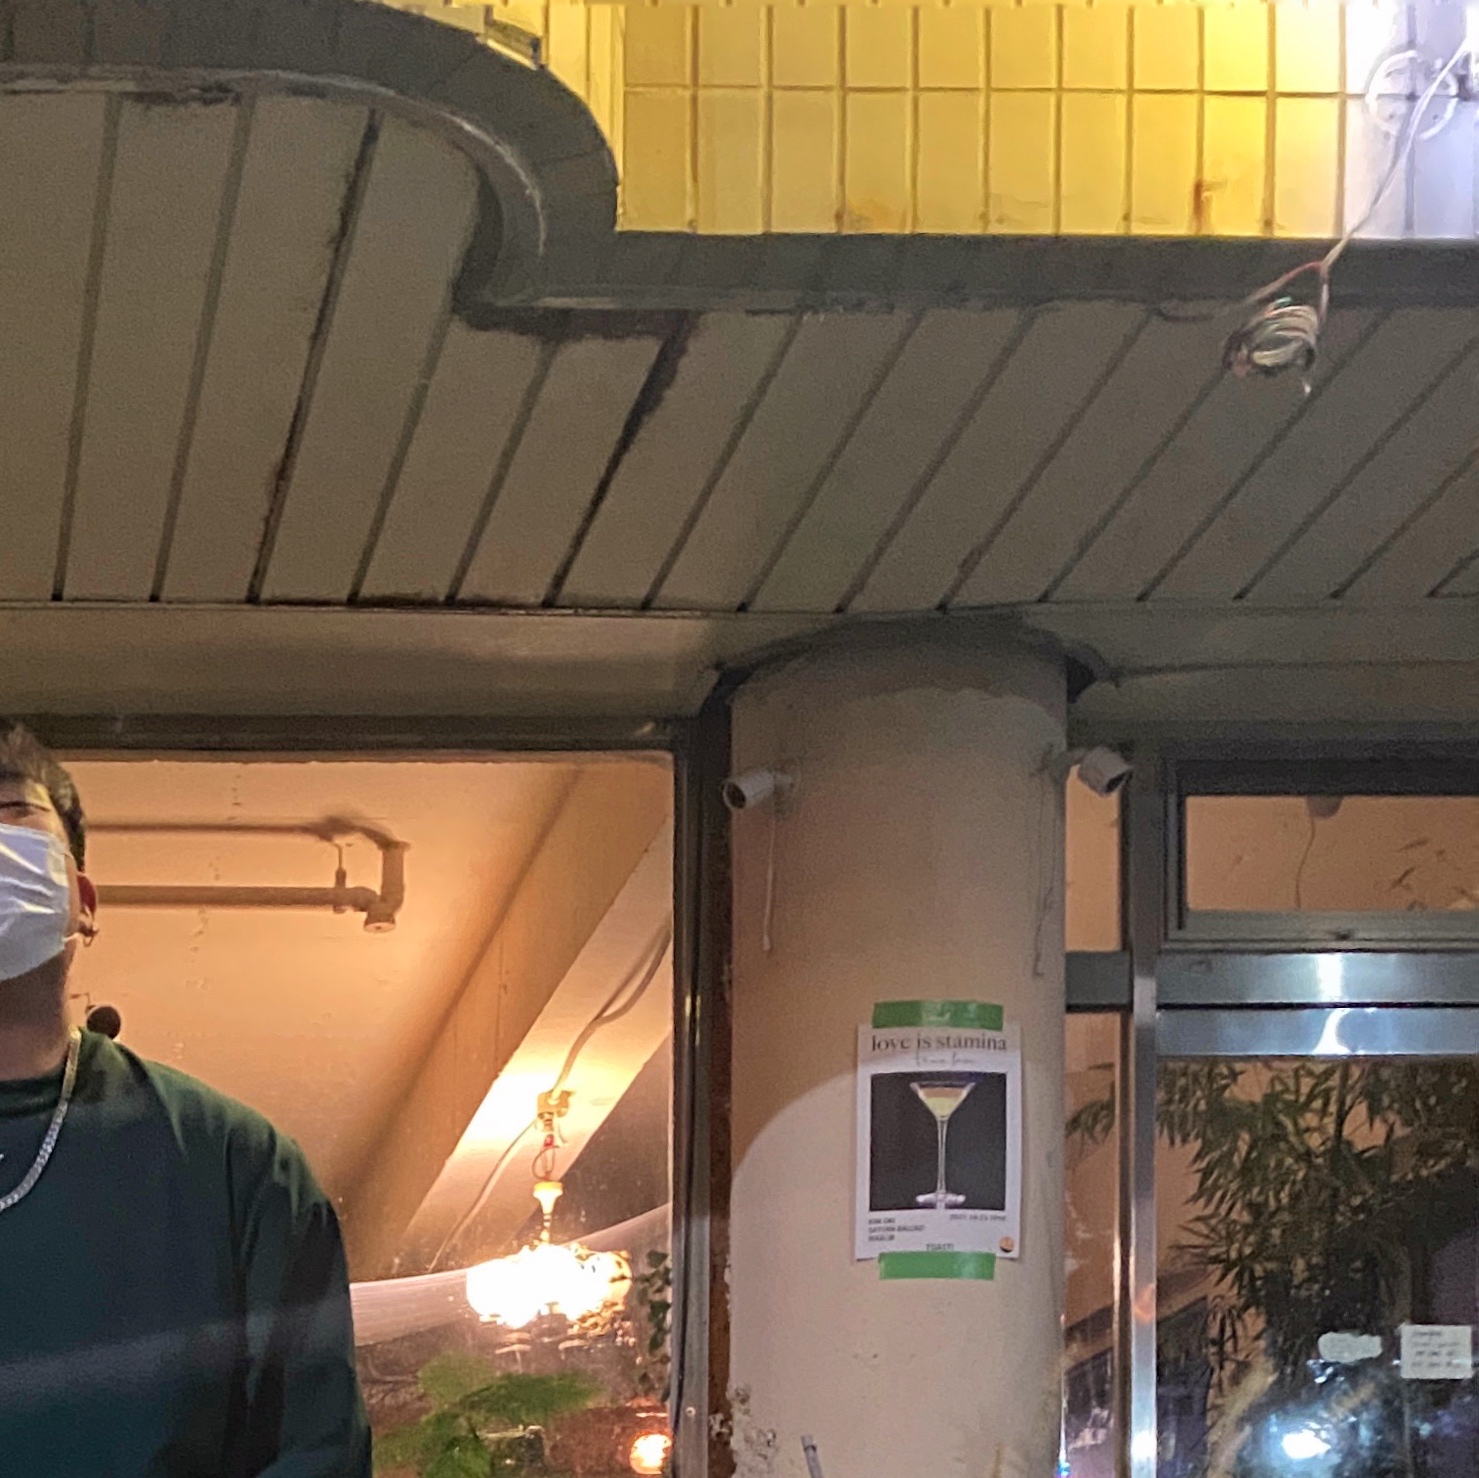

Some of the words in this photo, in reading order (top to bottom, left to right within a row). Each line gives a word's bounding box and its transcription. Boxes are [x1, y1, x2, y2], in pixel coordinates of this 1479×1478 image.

[872, 1034, 911, 1051] love
[916, 1032, 932, 1050] is
[936, 1033, 1007, 1051] stamina
